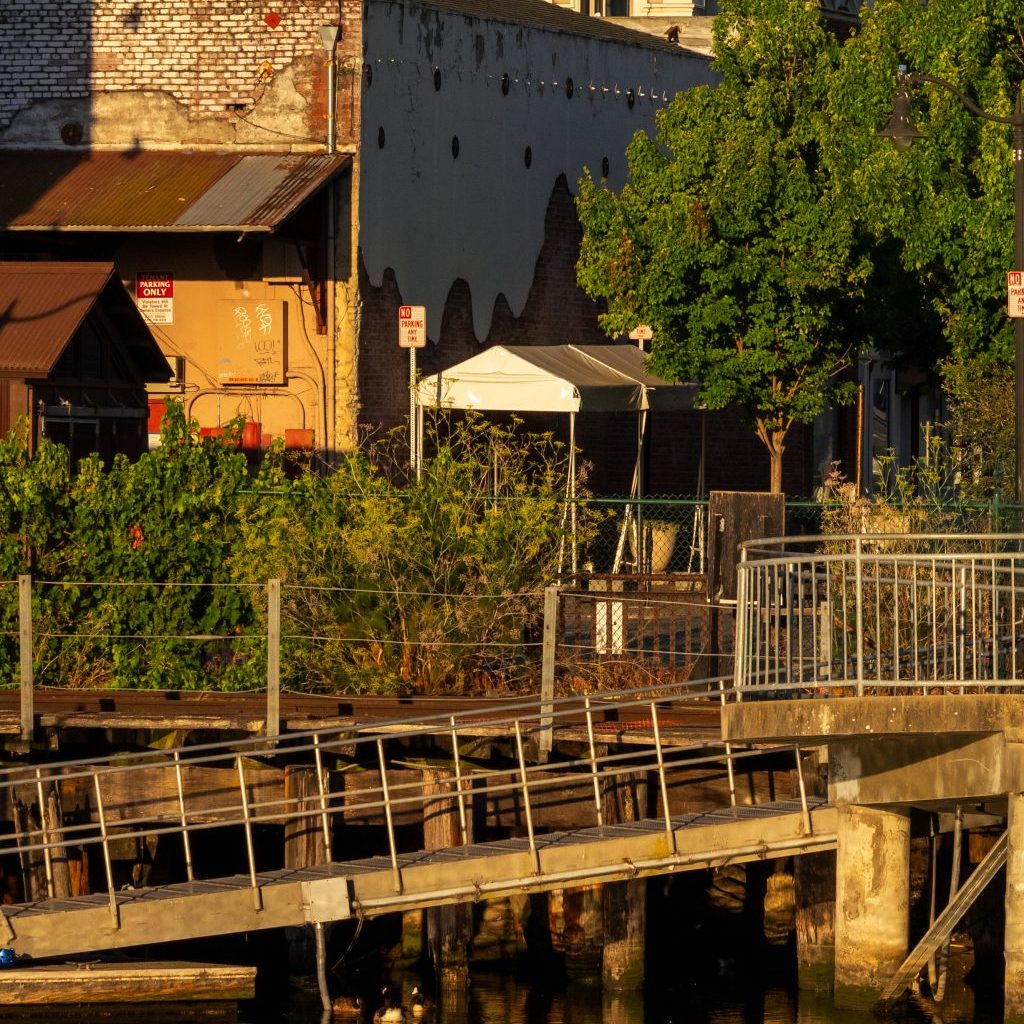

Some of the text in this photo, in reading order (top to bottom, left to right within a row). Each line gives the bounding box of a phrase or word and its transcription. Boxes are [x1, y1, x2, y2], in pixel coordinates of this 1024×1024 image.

[1010, 273, 1020, 285] NO
[143, 288, 166, 296] ONLY
[400, 308, 410, 318] NO
